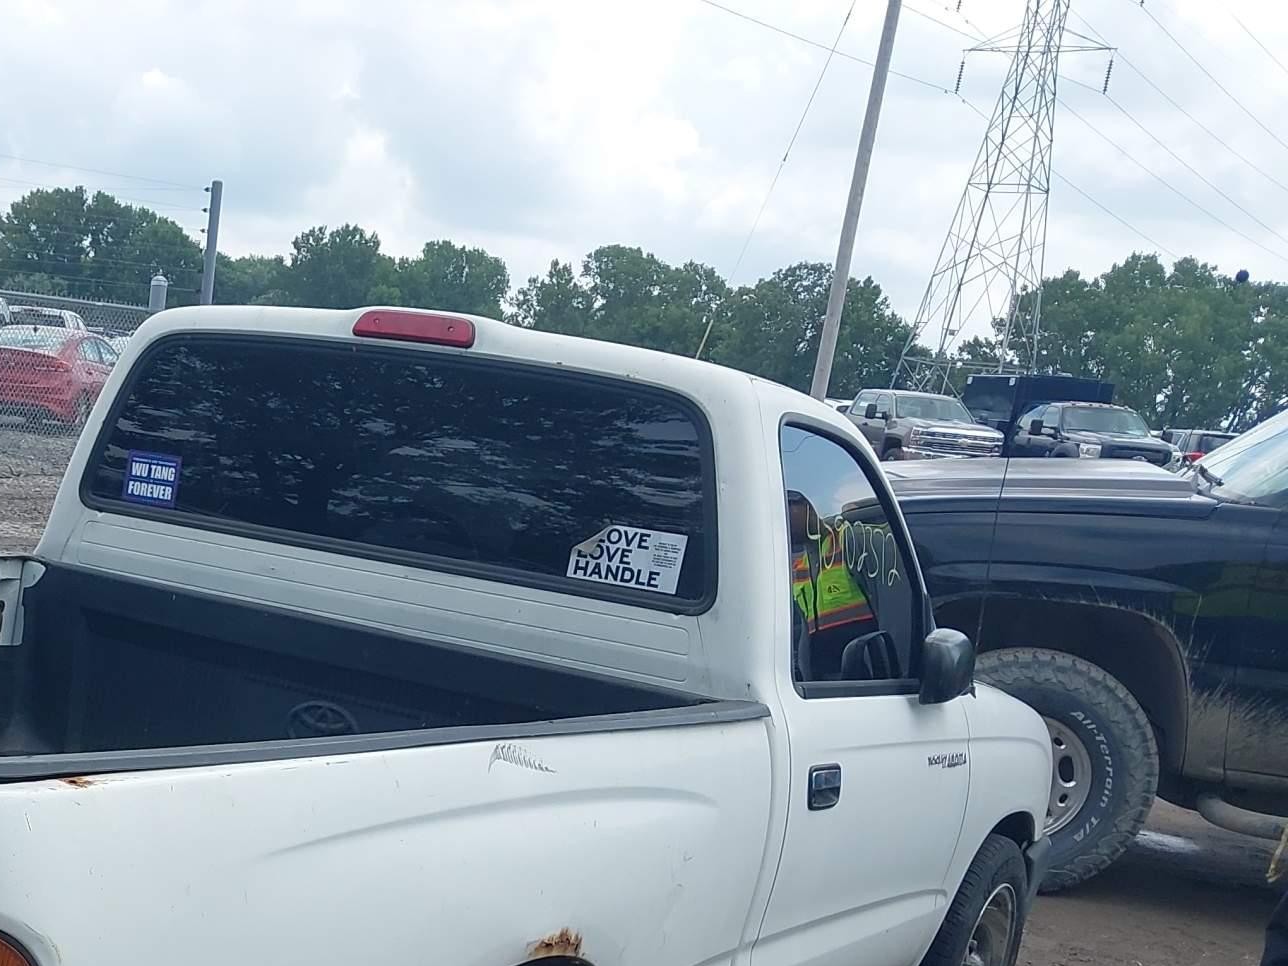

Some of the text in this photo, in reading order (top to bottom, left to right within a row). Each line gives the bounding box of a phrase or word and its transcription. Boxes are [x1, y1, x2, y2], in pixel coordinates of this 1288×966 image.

[132, 461, 149, 477] WU
[150, 464, 175, 482] TANG
[127, 480, 172, 500] FOREVER
[598, 528, 651, 550] OVE
[573, 559, 660, 588] HANDLE
[1069, 711, 1113, 808] All-Terrain
